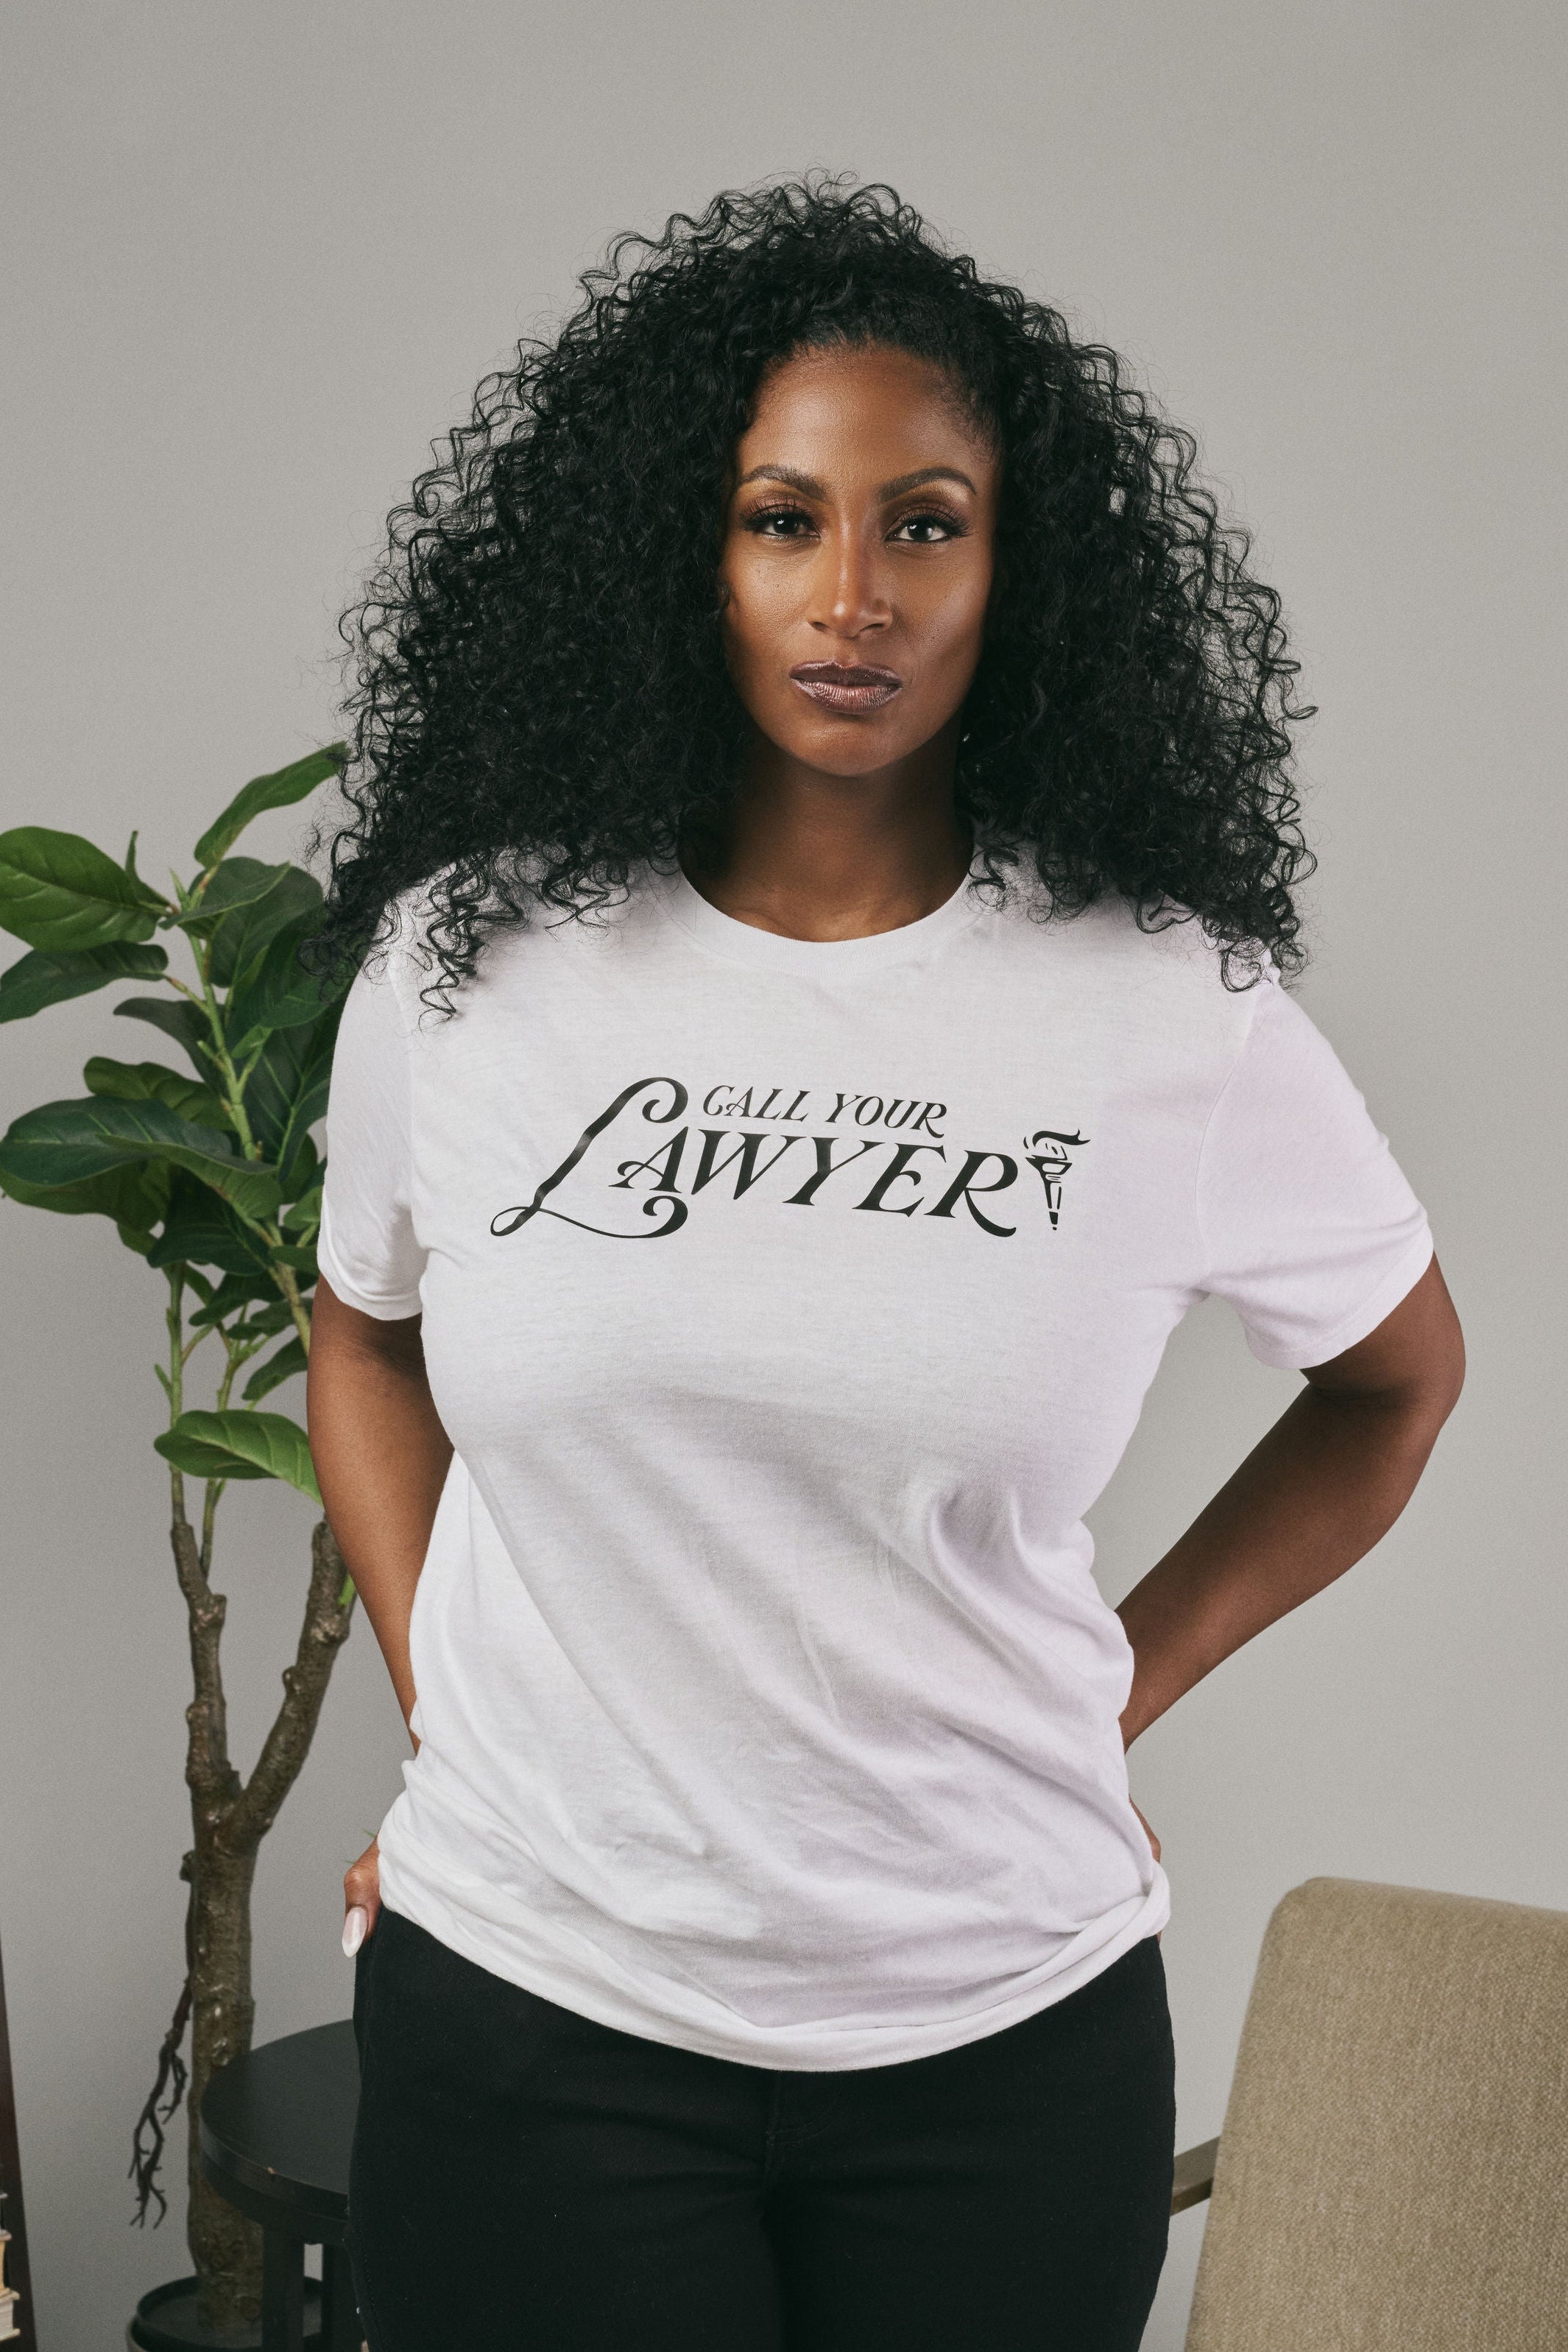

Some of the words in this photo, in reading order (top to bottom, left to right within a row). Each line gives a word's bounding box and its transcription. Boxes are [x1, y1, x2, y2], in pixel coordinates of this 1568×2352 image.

[490, 1077, 1018, 1239] LAWYER
[703, 1085, 811, 1122] CALL
[825, 1092, 947, 1139] YOUR
